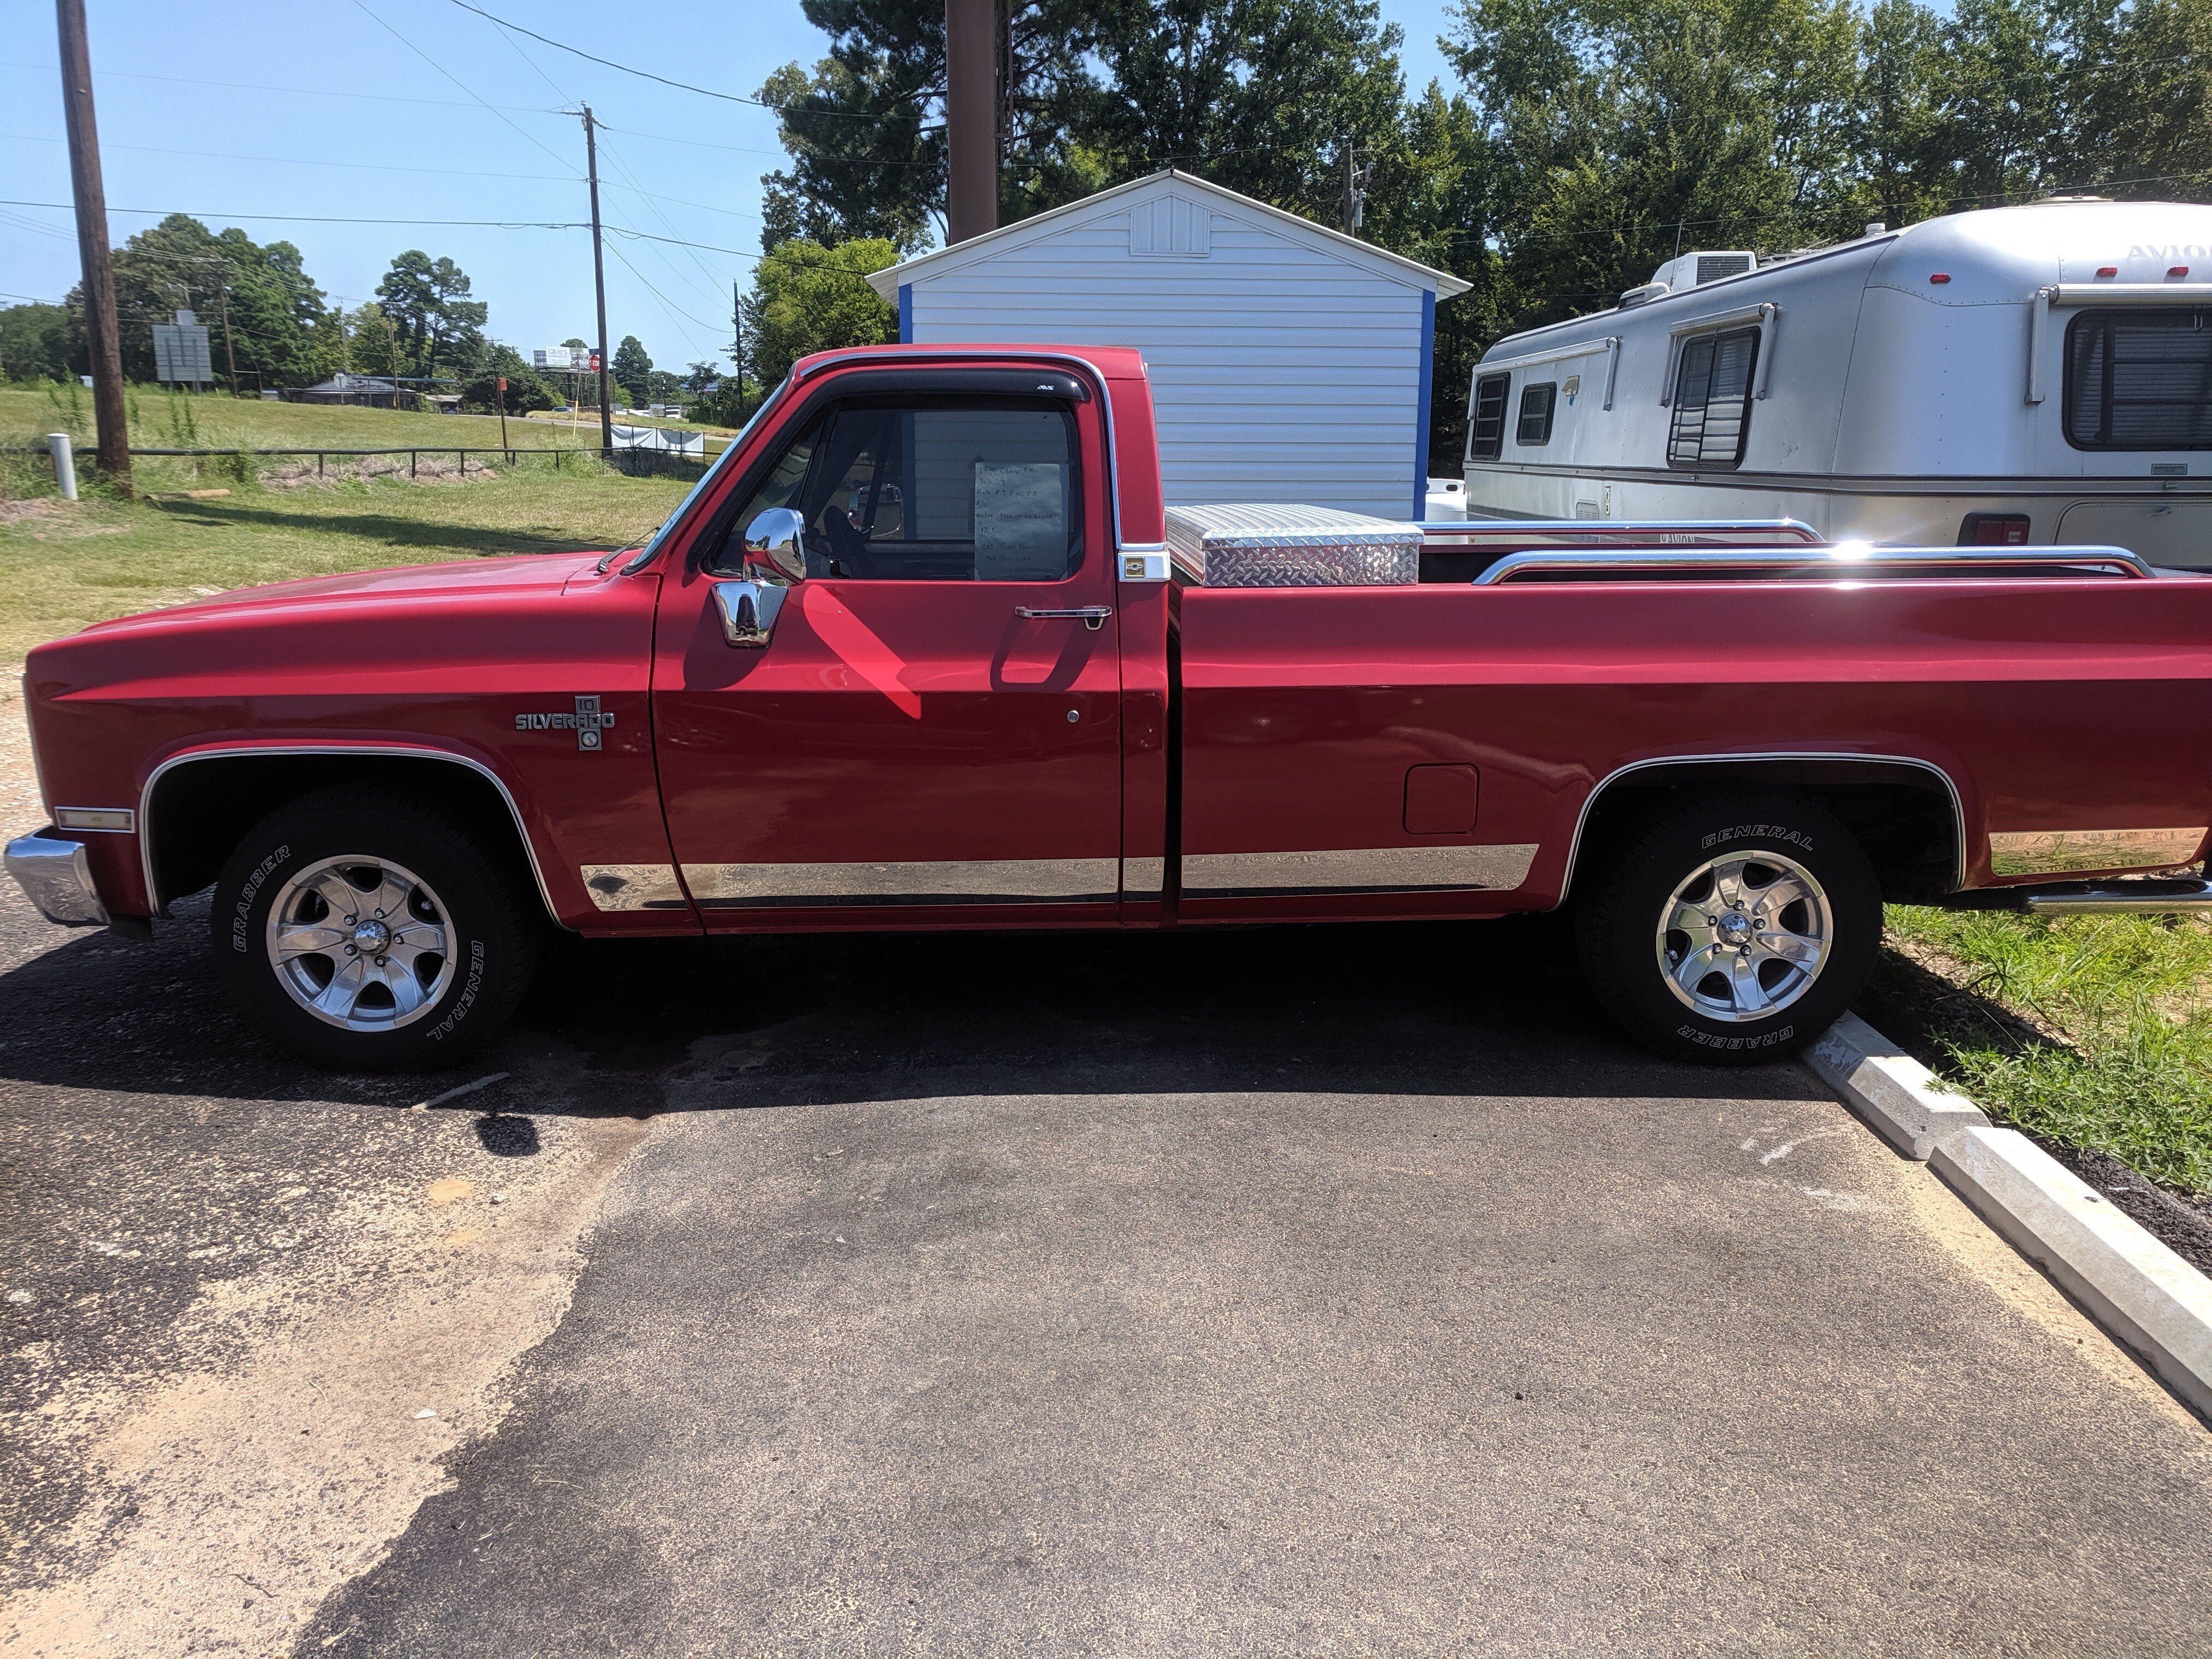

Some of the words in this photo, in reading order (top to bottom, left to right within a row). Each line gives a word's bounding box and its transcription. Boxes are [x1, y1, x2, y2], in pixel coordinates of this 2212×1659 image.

[2126, 245, 2212, 261] AVIO
[578, 699, 595, 710] 10
[515, 713, 615, 730] SILVERADO
[1702, 825, 1813, 851] GENERAL
[233, 845, 291, 952] GRABBER
[426, 940, 484, 1040] GENERAL
[1677, 1025, 1794, 1049] GRABBER
